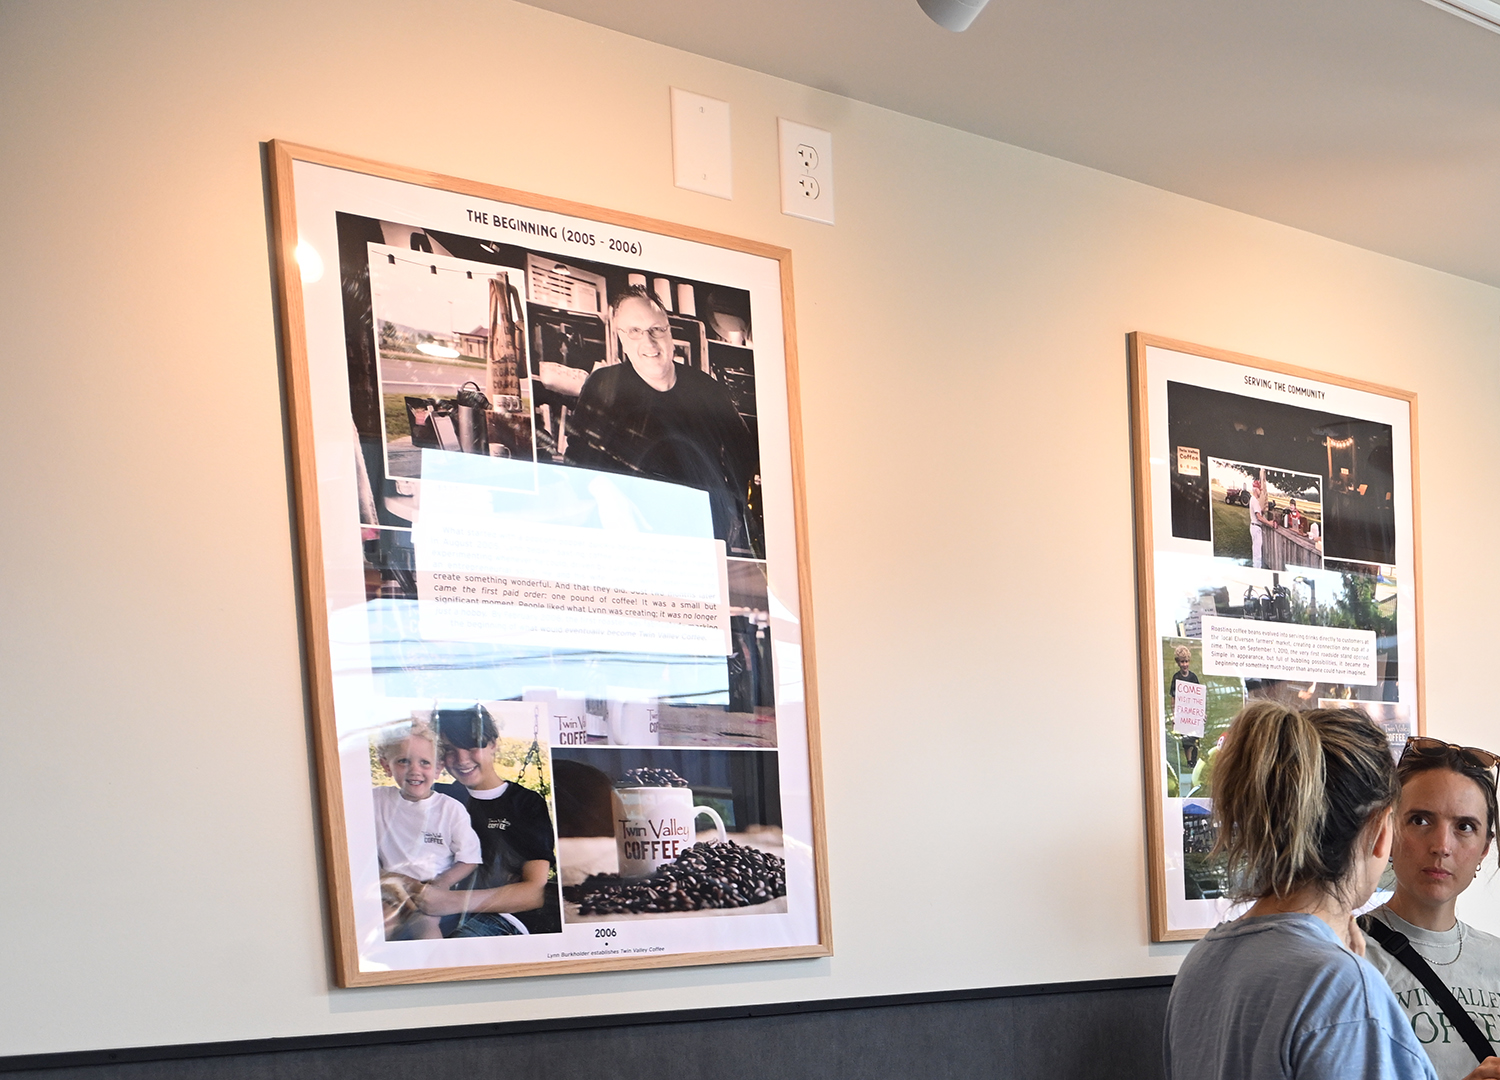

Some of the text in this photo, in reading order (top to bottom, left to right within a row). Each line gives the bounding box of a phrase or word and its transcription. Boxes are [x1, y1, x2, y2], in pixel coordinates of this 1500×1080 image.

[466, 209, 489, 225] THE
[493, 215, 558, 239] BEGINNING
[561, 226, 596, 246] (2005
[608, 238, 643, 256] 2006)
[1244, 375, 1326, 400] SERVING THE COMMUNITY
[1180, 453, 1199, 461] Coffee
[433, 573, 461, 581] create
[465, 575, 507, 586] something
[511, 579, 552, 588] wonderful.
[555, 582, 570, 590] And
[573, 583, 590, 592] that
[593, 585, 610, 593] they
[433, 584, 457, 592] came
[481, 587, 498, 595] first
[503, 588, 519, 597] paid
[524, 590, 547, 599] order:
[552, 593, 565, 601] one
[570, 594, 595, 603] pound
[612, 597, 638, 605] coffee!
[680, 602, 701, 610] small
[704, 603, 717, 611] but
[434, 595, 479, 606] significant
[546, 603, 565, 611] liked
[567, 604, 586, 613] what
[588, 606, 607, 615] Lynn
[608, 607, 623, 615] was
[694, 613, 717, 622] longer
[1177, 683, 1203, 696] COME
[1177, 696, 1204, 706] VISIT THE
[1177, 705, 1205, 718] FARMERS
[553, 715, 578, 731] Twin
[1180, 717, 1201, 727] MARKET
[618, 818, 690, 842] Twin Valley
[624, 840, 680, 860] COFFEE
[594, 928, 617, 938] 2006
[561, 950, 589, 958] Burkholder
[1396, 986, 1438, 1009] WIN
